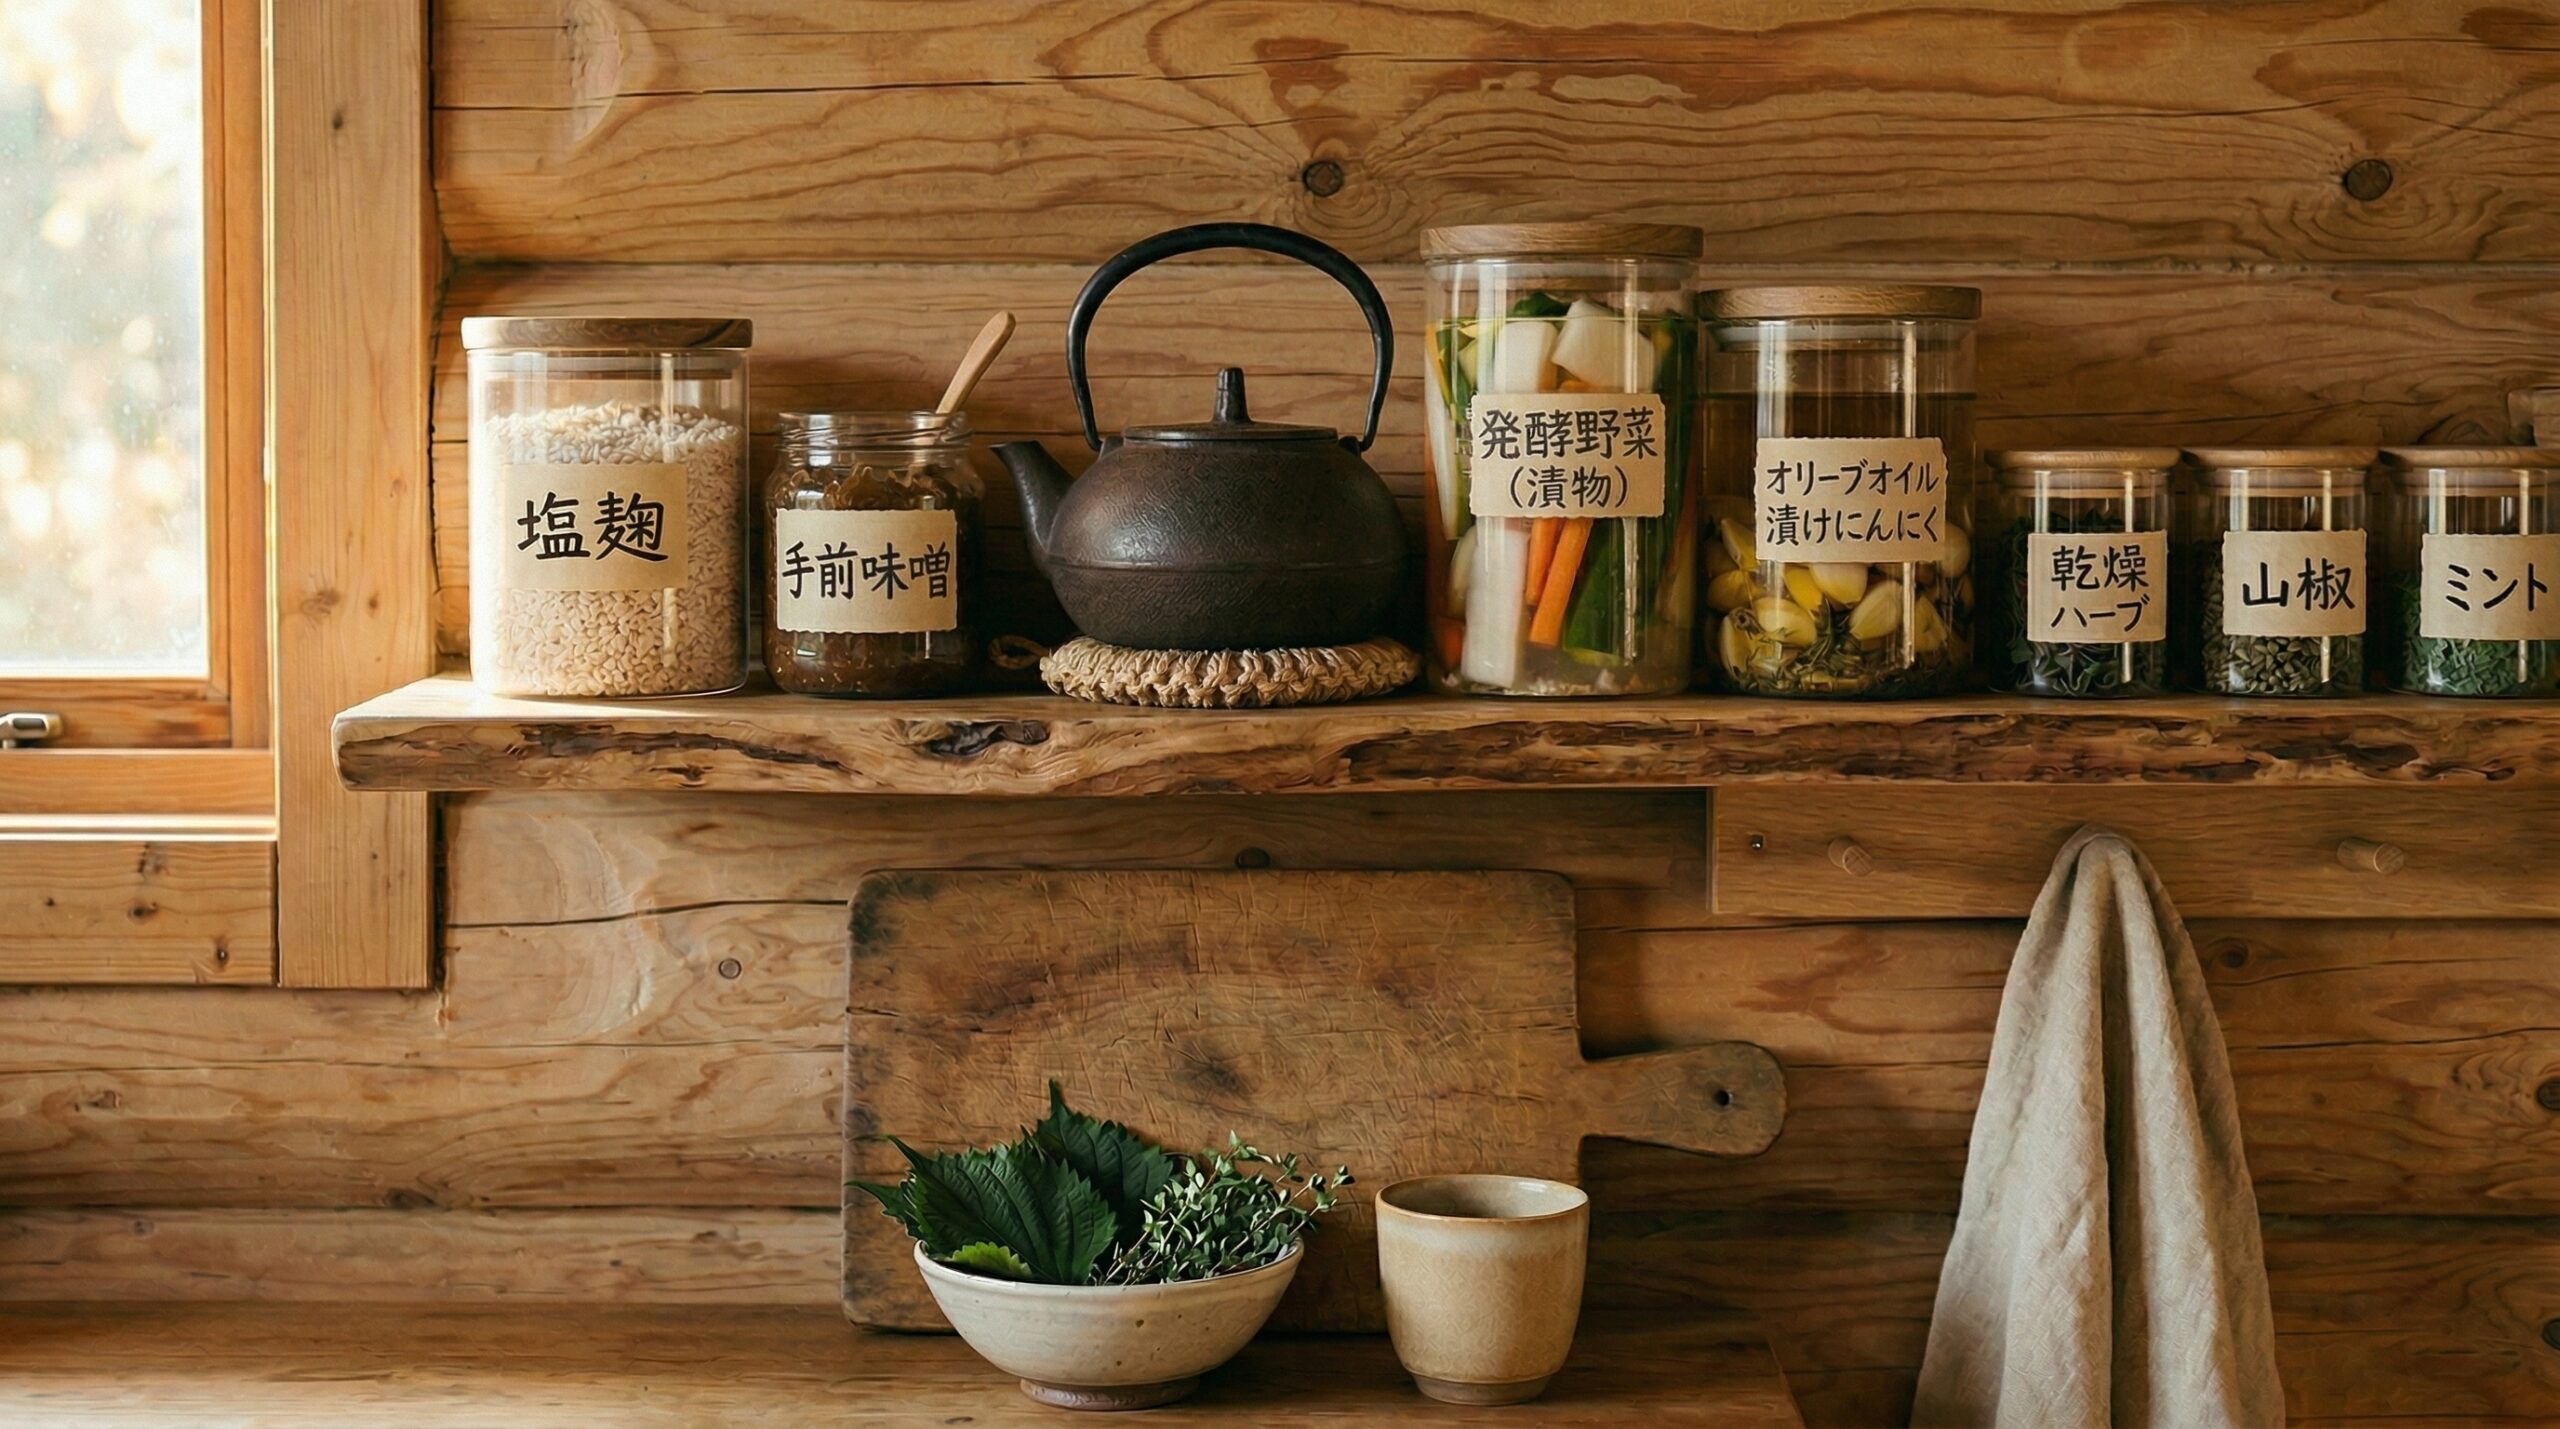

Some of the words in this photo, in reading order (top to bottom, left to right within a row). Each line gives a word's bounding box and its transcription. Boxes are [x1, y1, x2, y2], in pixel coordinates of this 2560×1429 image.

[1479, 406, 1658, 460] 発酵野菜
[1510, 465, 1628, 509] （漬物）
[1767, 458, 1940, 496] オリーブオイル
[517, 491, 669, 562] 塩麹
[1766, 503, 1938, 546] 漬けにんにく
[782, 540, 952, 600] 手前味噌
[2051, 544, 2150, 593] 乾燥
[2242, 557, 2356, 611] 山椒
[2445, 562, 2549, 612] ミント
[2051, 593, 2151, 632] ハーブ
